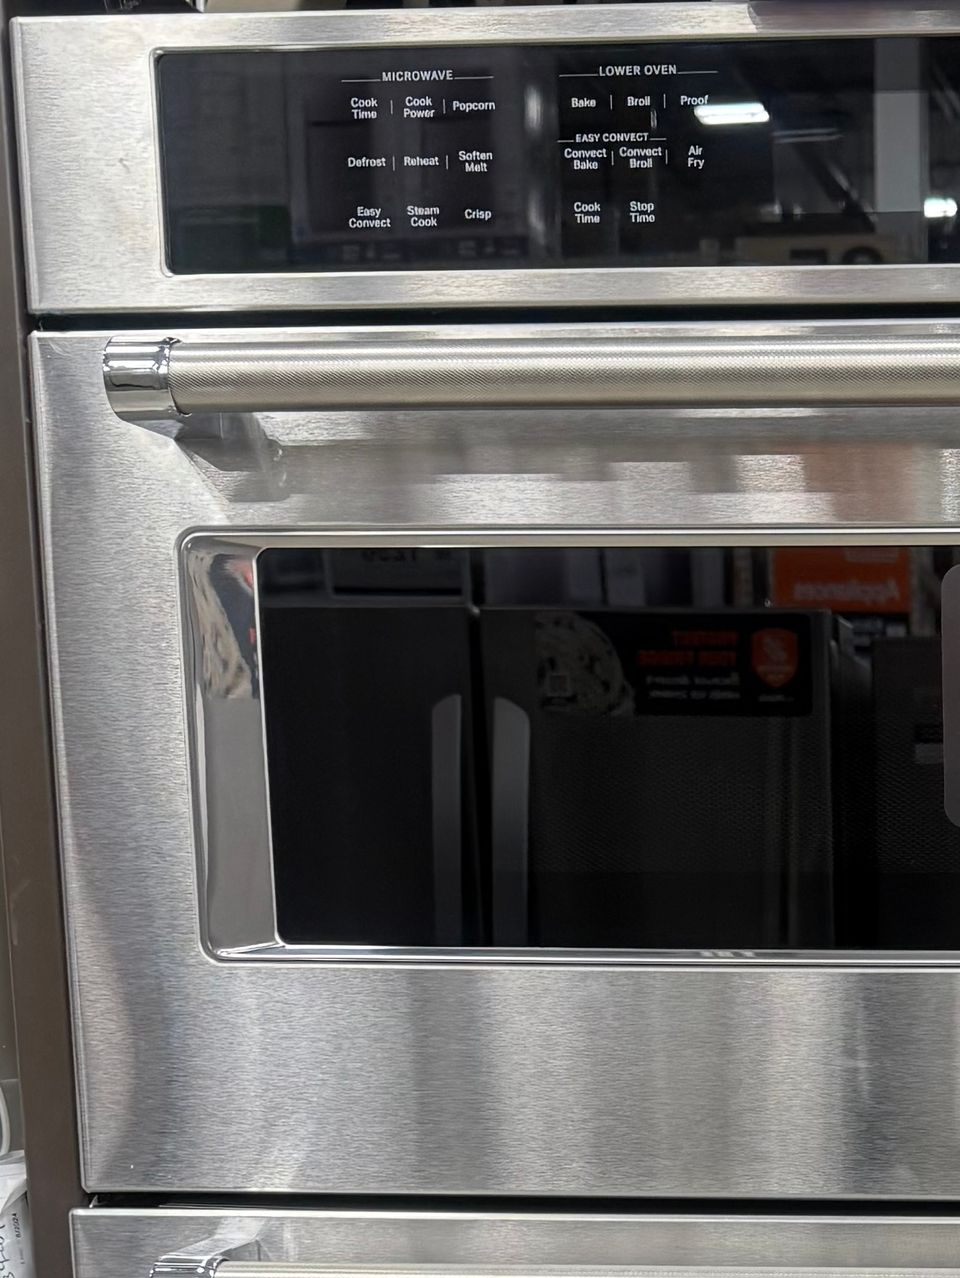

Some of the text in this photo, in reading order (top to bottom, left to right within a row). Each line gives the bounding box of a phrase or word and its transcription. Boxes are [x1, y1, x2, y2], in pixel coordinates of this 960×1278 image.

[600, 64, 677, 76] LOWER OVEN
[382, 70, 453, 81] MICROWAVE
[351, 97, 378, 108] Cook
[405, 96, 432, 106] Cook
[571, 97, 596, 107] Bake
[627, 96, 650, 106] Broil
[680, 95, 709, 105] Proof
[453, 101, 496, 112] Popcorn
[352, 109, 377, 119] Time
[404, 108, 435, 118] Power
[576, 132, 649, 143] EASY CONVECT
[564, 148, 607, 158] Convect
[619, 147, 662, 157] Convect
[688, 145, 703, 156] Air
[404, 156, 439, 166] Reheat
[459, 151, 493, 161] Soften
[348, 157, 386, 167] Defrost
[465, 162, 488, 172] Melt
[573, 159, 598, 170] Bake
[629, 158, 653, 168] Broil
[688, 157, 704, 169] Fry
[357, 206, 381, 218] Easy
[407, 206, 440, 216] Steam
[574, 202, 600, 212] Cook
[630, 201, 654, 213] Stop
[464, 209, 492, 220] Crisp
[575, 213, 600, 224] Time
[630, 213, 655, 223] Time
[349, 218, 391, 228] Convect
[411, 217, 437, 227] Cook
